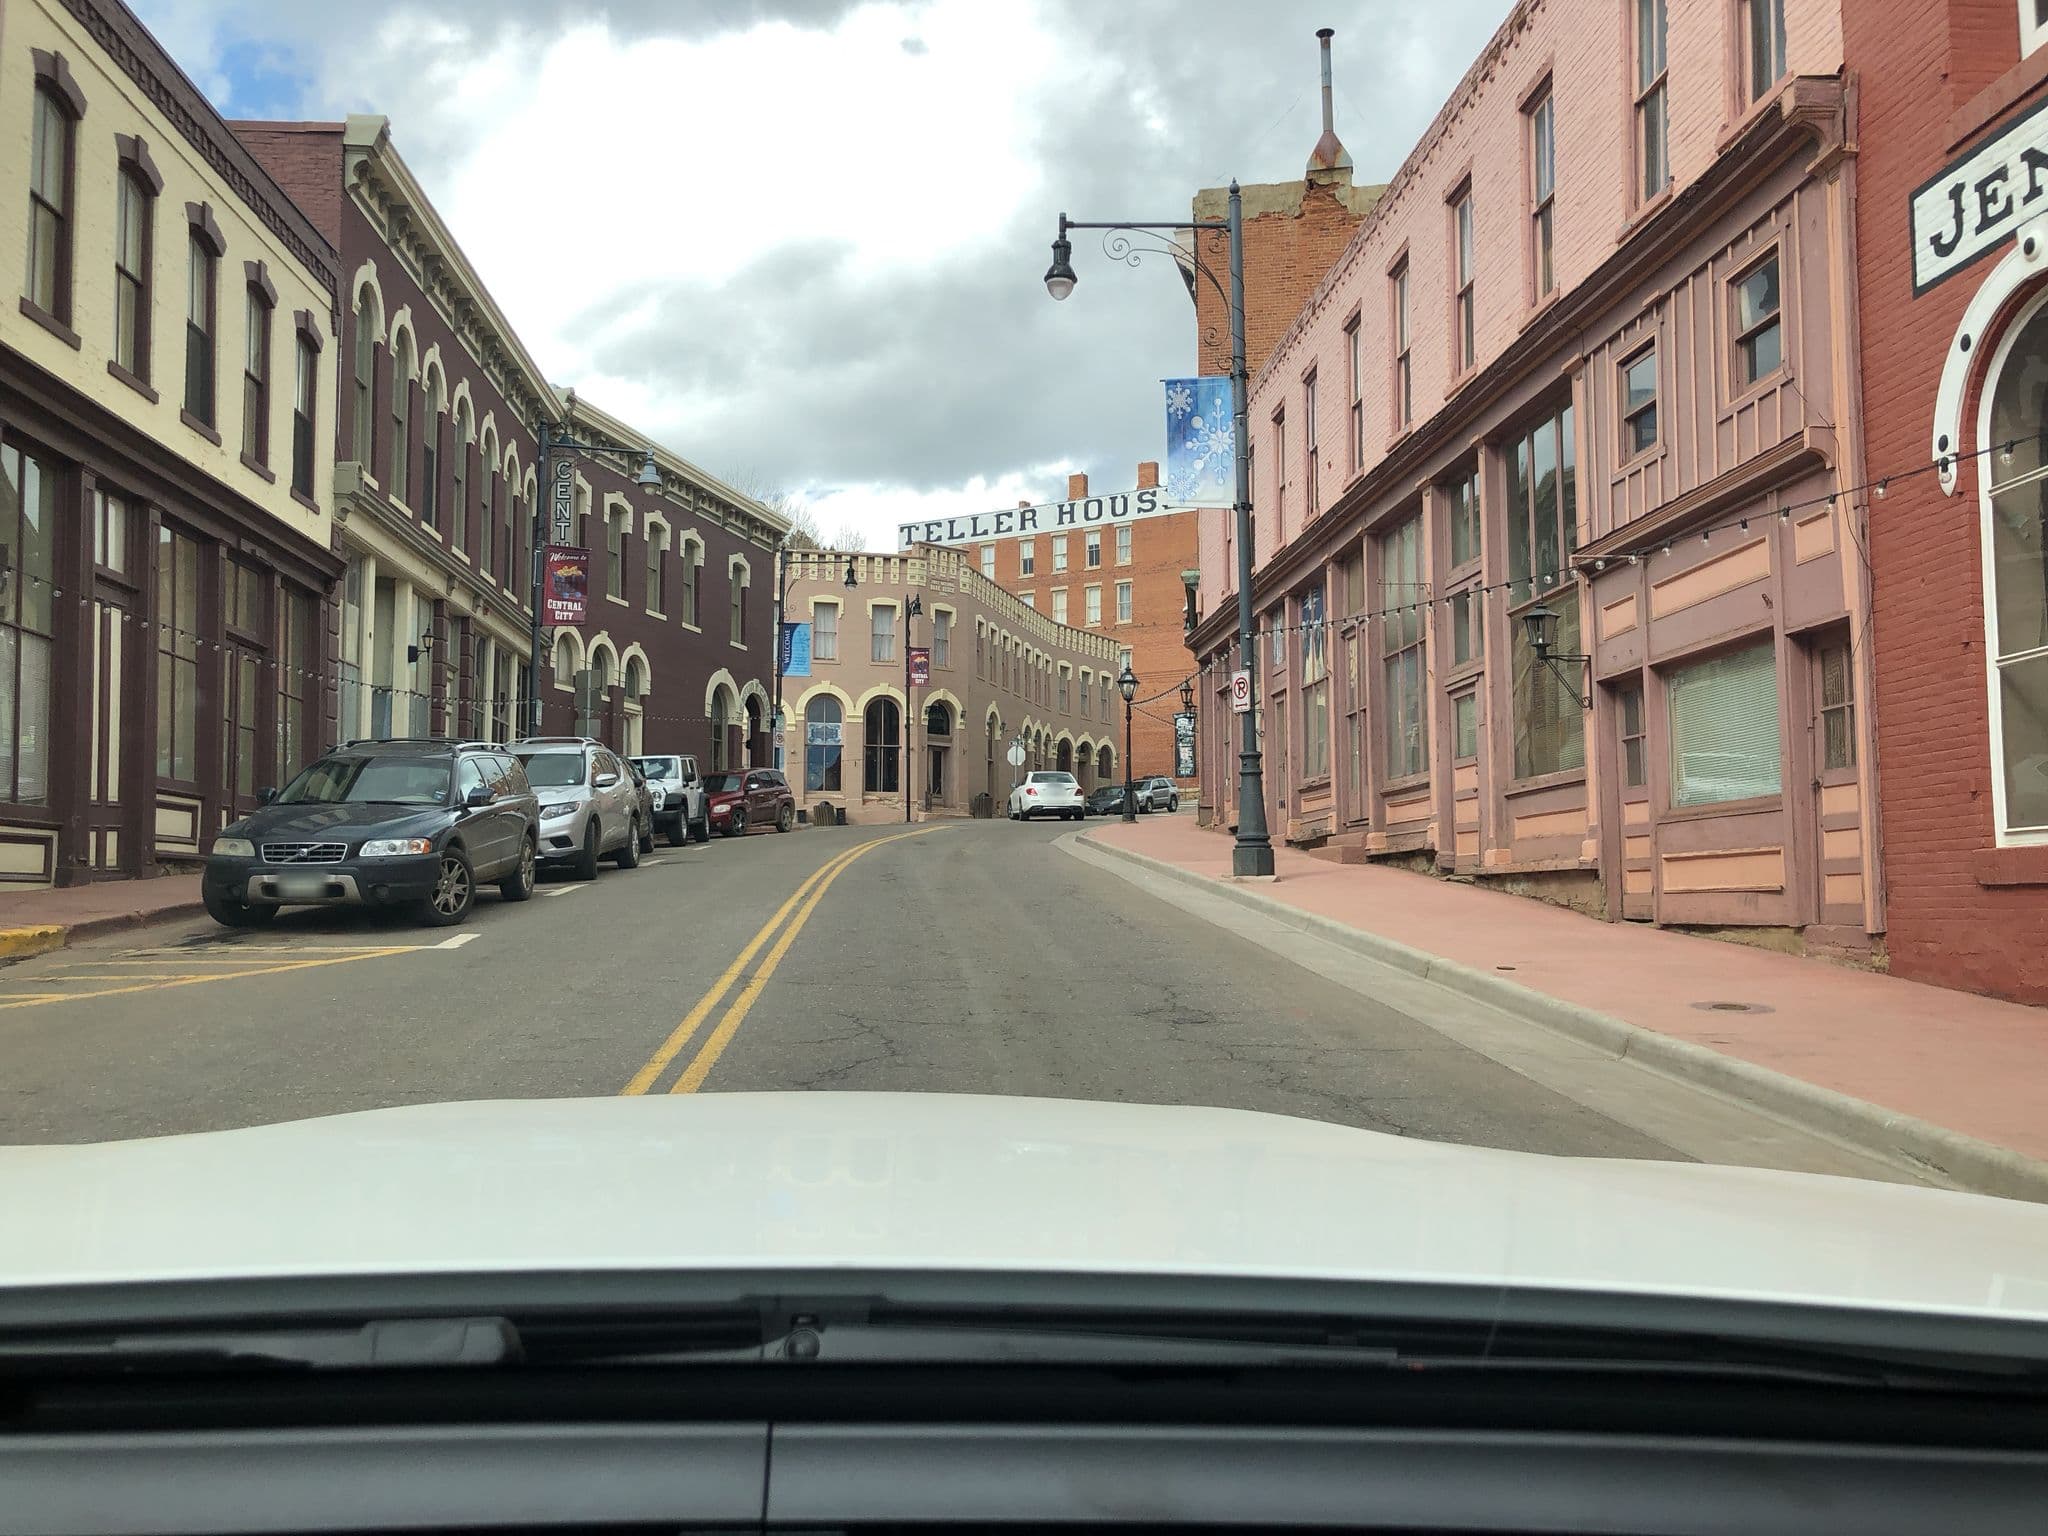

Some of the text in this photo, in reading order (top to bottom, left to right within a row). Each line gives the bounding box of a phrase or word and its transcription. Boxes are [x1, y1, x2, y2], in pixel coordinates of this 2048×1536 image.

[555, 461, 572, 546] CENT
[899, 488, 1169, 546] TELLER HOUS
[547, 598, 583, 611] CENTRAL
[554, 610, 574, 621] CITY
[783, 629, 791, 664] WELCOME
